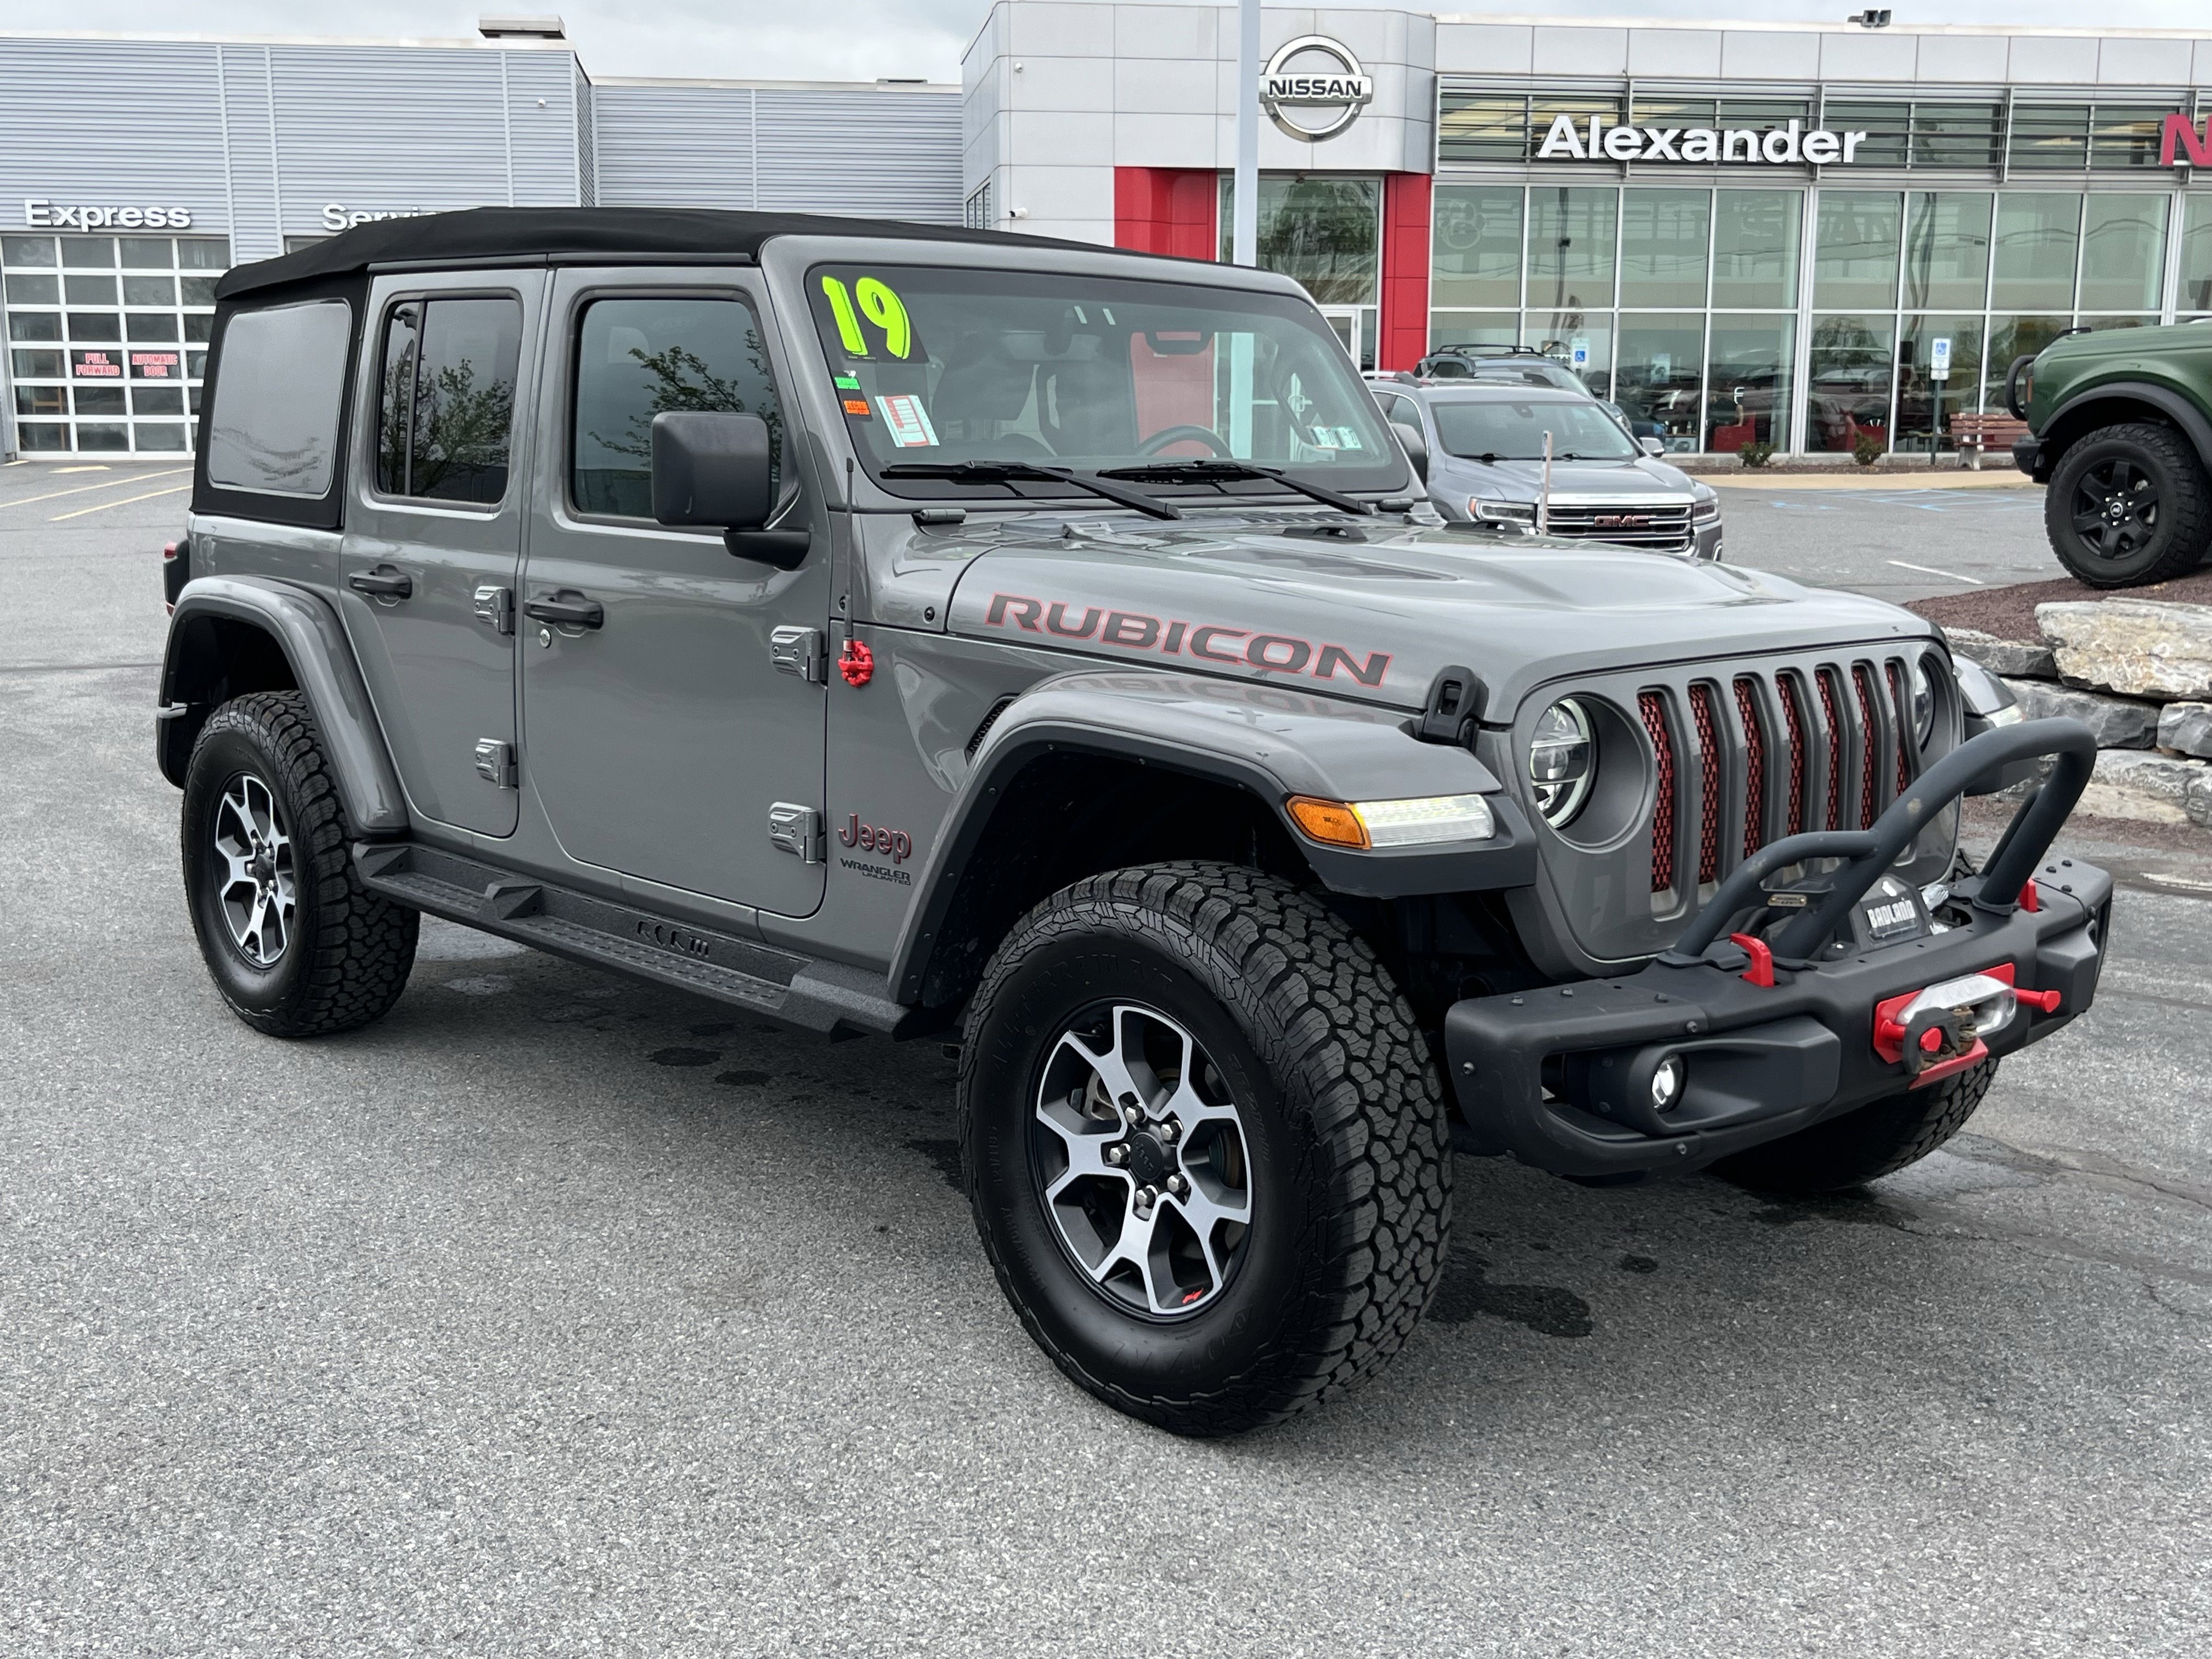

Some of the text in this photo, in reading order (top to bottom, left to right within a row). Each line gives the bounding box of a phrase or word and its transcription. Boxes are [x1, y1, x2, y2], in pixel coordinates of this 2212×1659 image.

[1268, 79, 1362, 97] NISSAN
[1537, 114, 1867, 165] Alexander
[24, 199, 192, 233] Express
[823, 276, 911, 359] 19
[85, 353, 109, 364] PULL
[132, 353, 178, 365] AUTOMATIC
[76, 364, 120, 376] FORWARD
[143, 365, 168, 376] DOOR
[1594, 515, 1650, 527] GMC
[985, 592, 1394, 689] RUBICON
[838, 813, 911, 864] Jeep
[840, 857, 910, 881] WRANGLER
[862, 871, 911, 886] UNLIMITED
[1866, 899, 1916, 929] BADLAND
